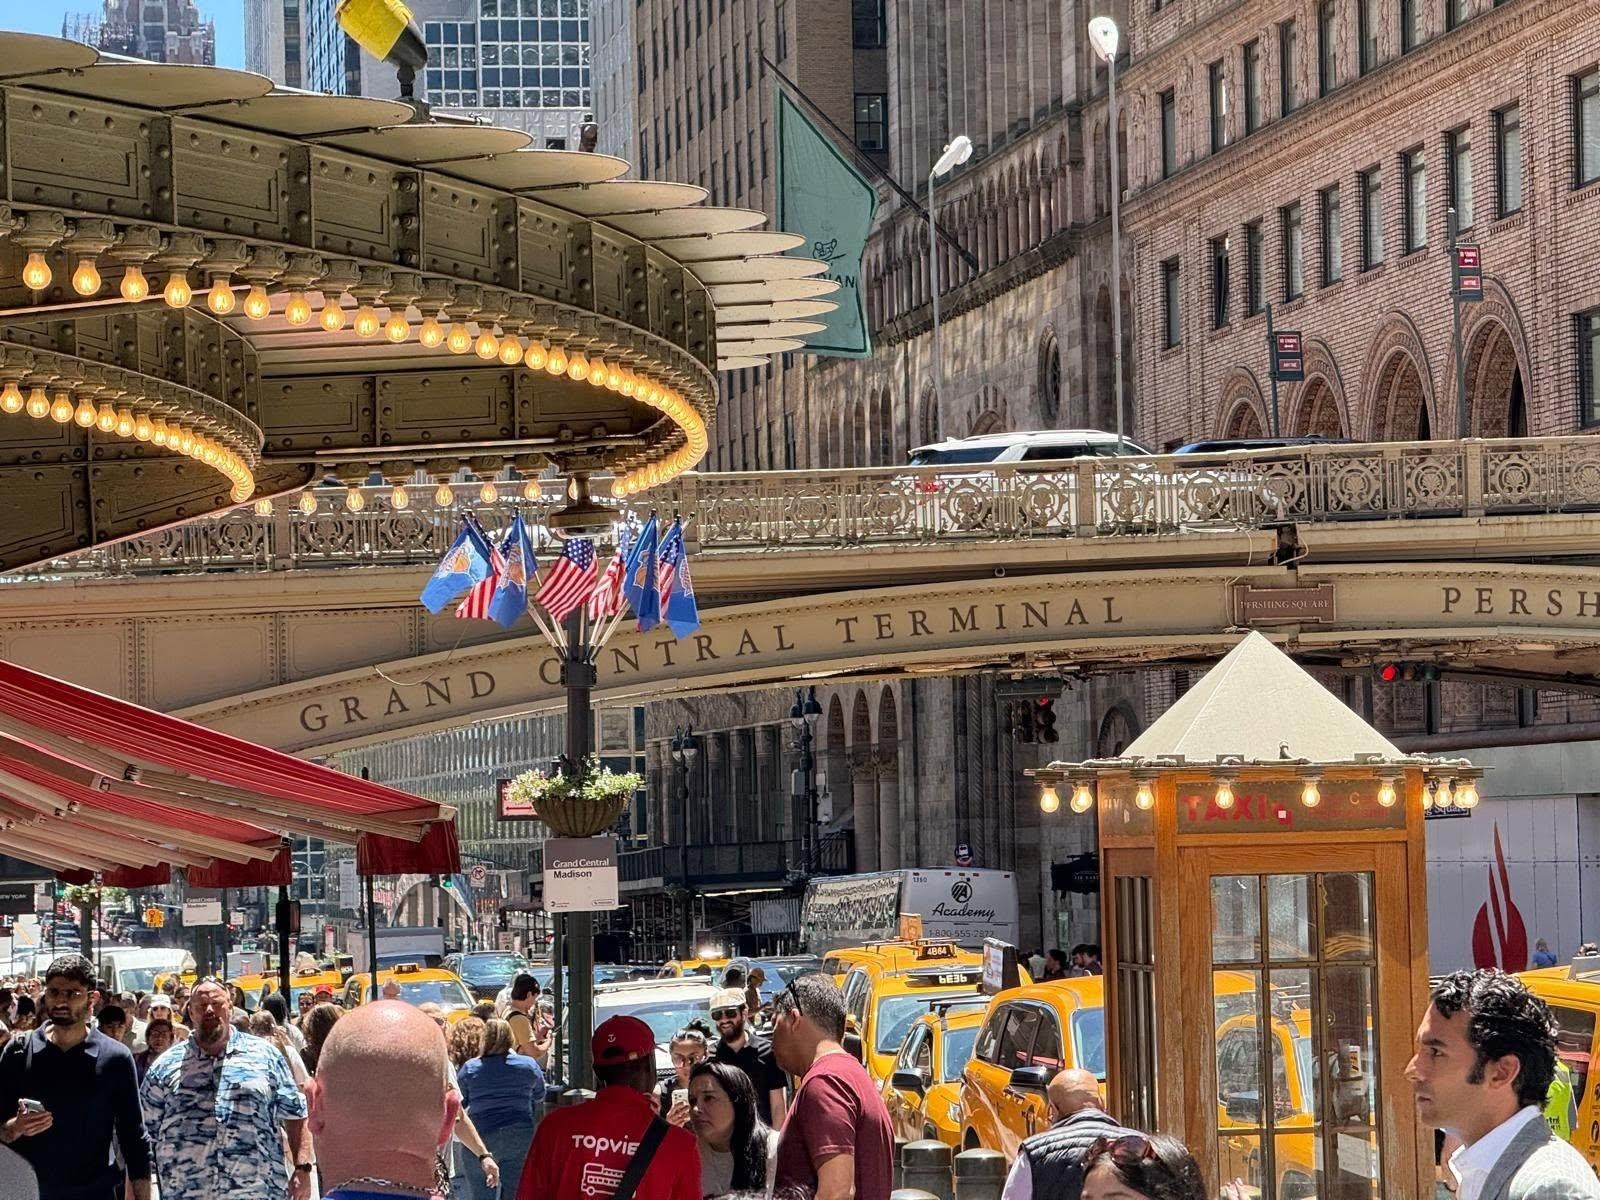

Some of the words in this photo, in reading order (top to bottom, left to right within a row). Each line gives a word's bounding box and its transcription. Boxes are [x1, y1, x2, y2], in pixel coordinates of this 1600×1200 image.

[1291, 600, 1330, 609] SQUARE
[1442, 587, 1600, 617] PERSH
[300, 670, 496, 732] GRAND
[538, 624, 795, 686] CNTRAL
[836, 597, 1123, 643] TERMINAL
[553, 860, 578, 868] Grand
[579, 858, 609, 867] Central
[553, 870, 592, 878] Madison
[931, 902, 996, 922] Academy
